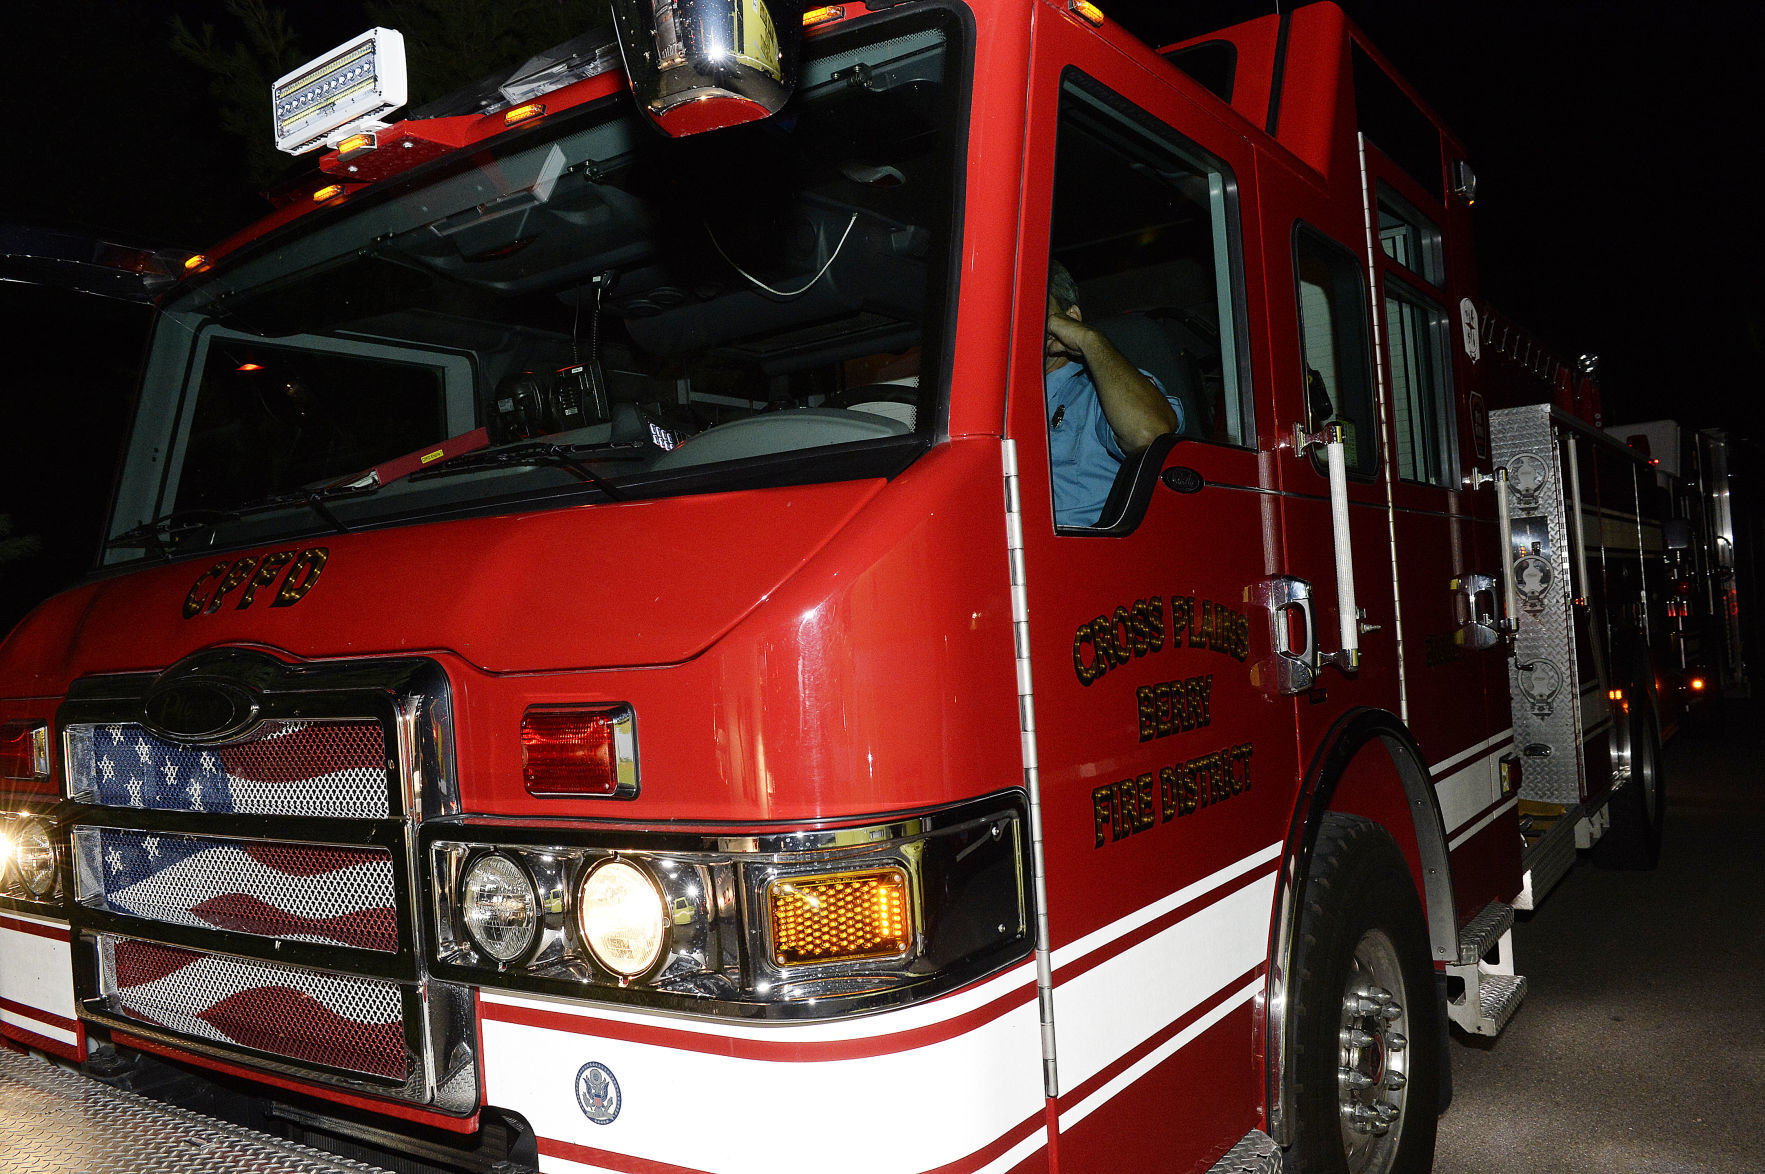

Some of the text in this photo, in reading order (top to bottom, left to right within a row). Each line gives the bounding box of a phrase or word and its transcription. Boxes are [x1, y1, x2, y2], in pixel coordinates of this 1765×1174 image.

[183, 547, 330, 619] CPFD
[1073, 596, 1250, 686] CROSS PLAINS
[1136, 674, 1213, 743] BERRY
[1092, 742, 1253, 849] FIRE DISTRICT
